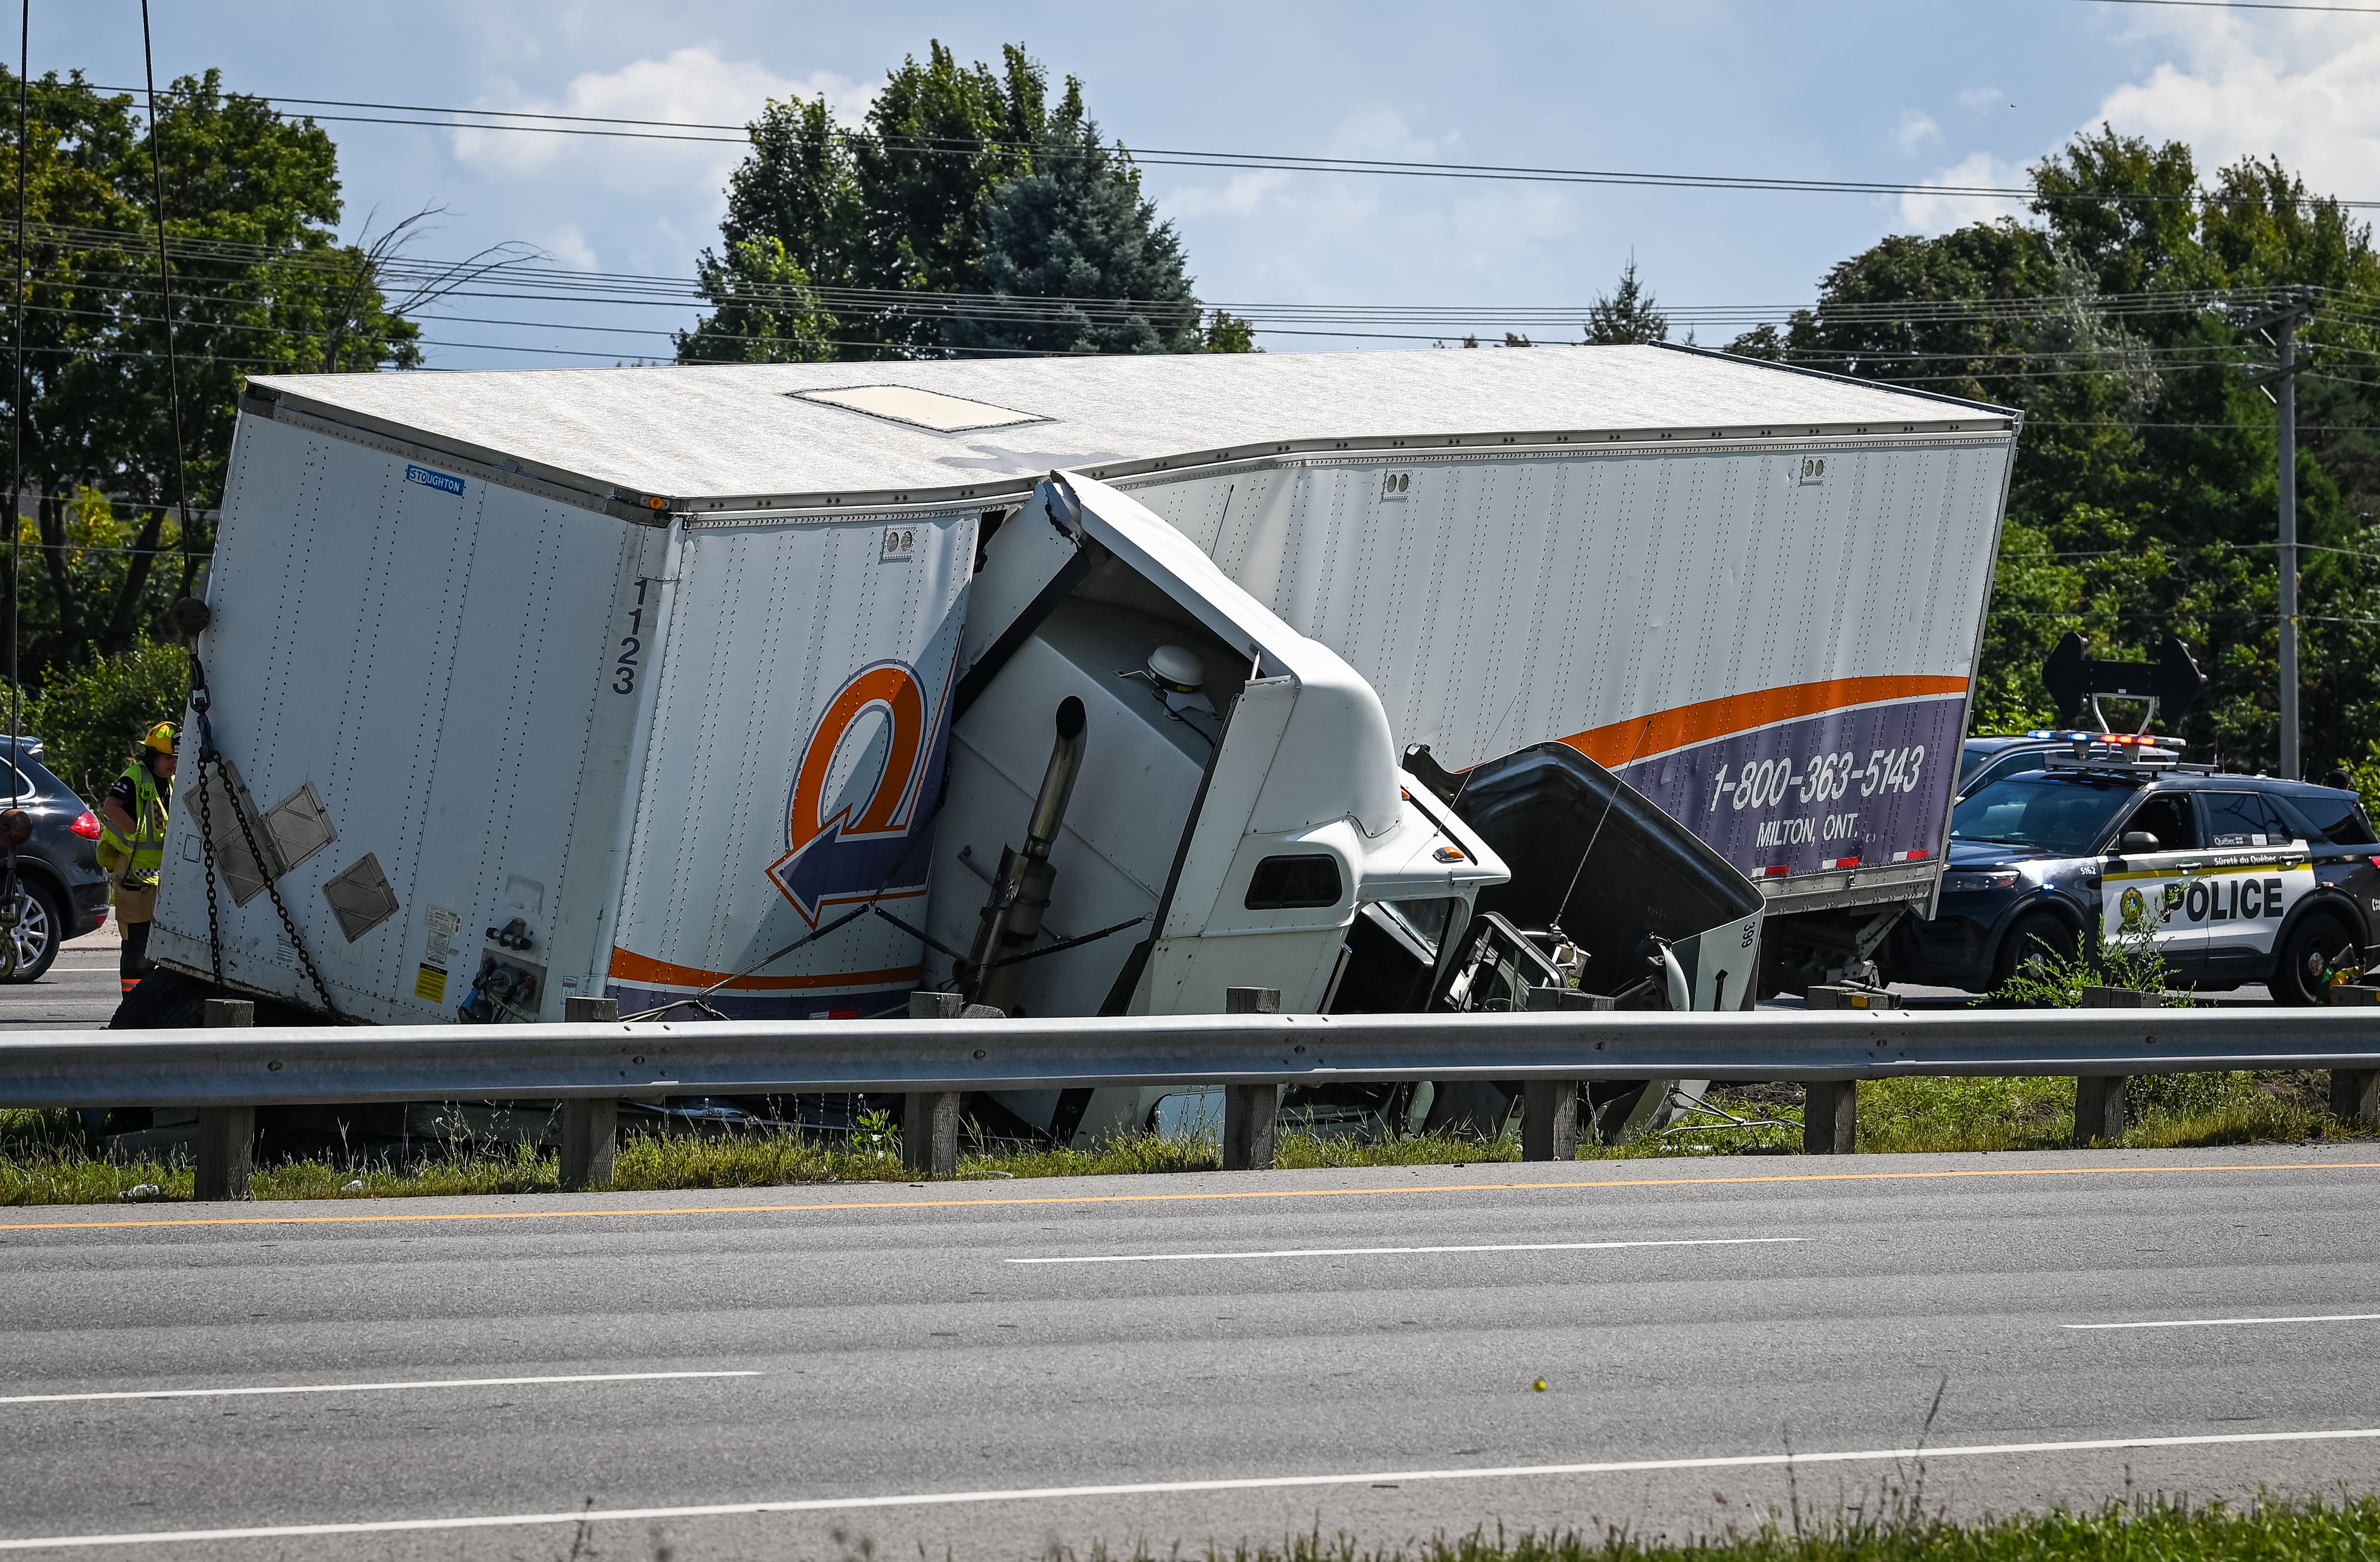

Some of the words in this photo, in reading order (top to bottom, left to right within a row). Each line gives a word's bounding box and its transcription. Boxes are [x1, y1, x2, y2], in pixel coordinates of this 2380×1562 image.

[410, 469, 459, 491] STOUGHTON
[612, 579, 648, 695] 1123
[1710, 745, 1925, 812] 1-800-363-5143
[1756, 817, 1816, 847] MILTON,
[1823, 812, 1858, 841] ONT.
[2214, 837, 2235, 846] Québec
[2080, 866, 2096, 875] 5162
[2213, 855, 2238, 866] Sûreté
[2239, 856, 2249, 864] du
[2250, 854, 2277, 865] Québec
[2162, 878, 2283, 923] POLICE
[1741, 921, 1756, 948] 399
